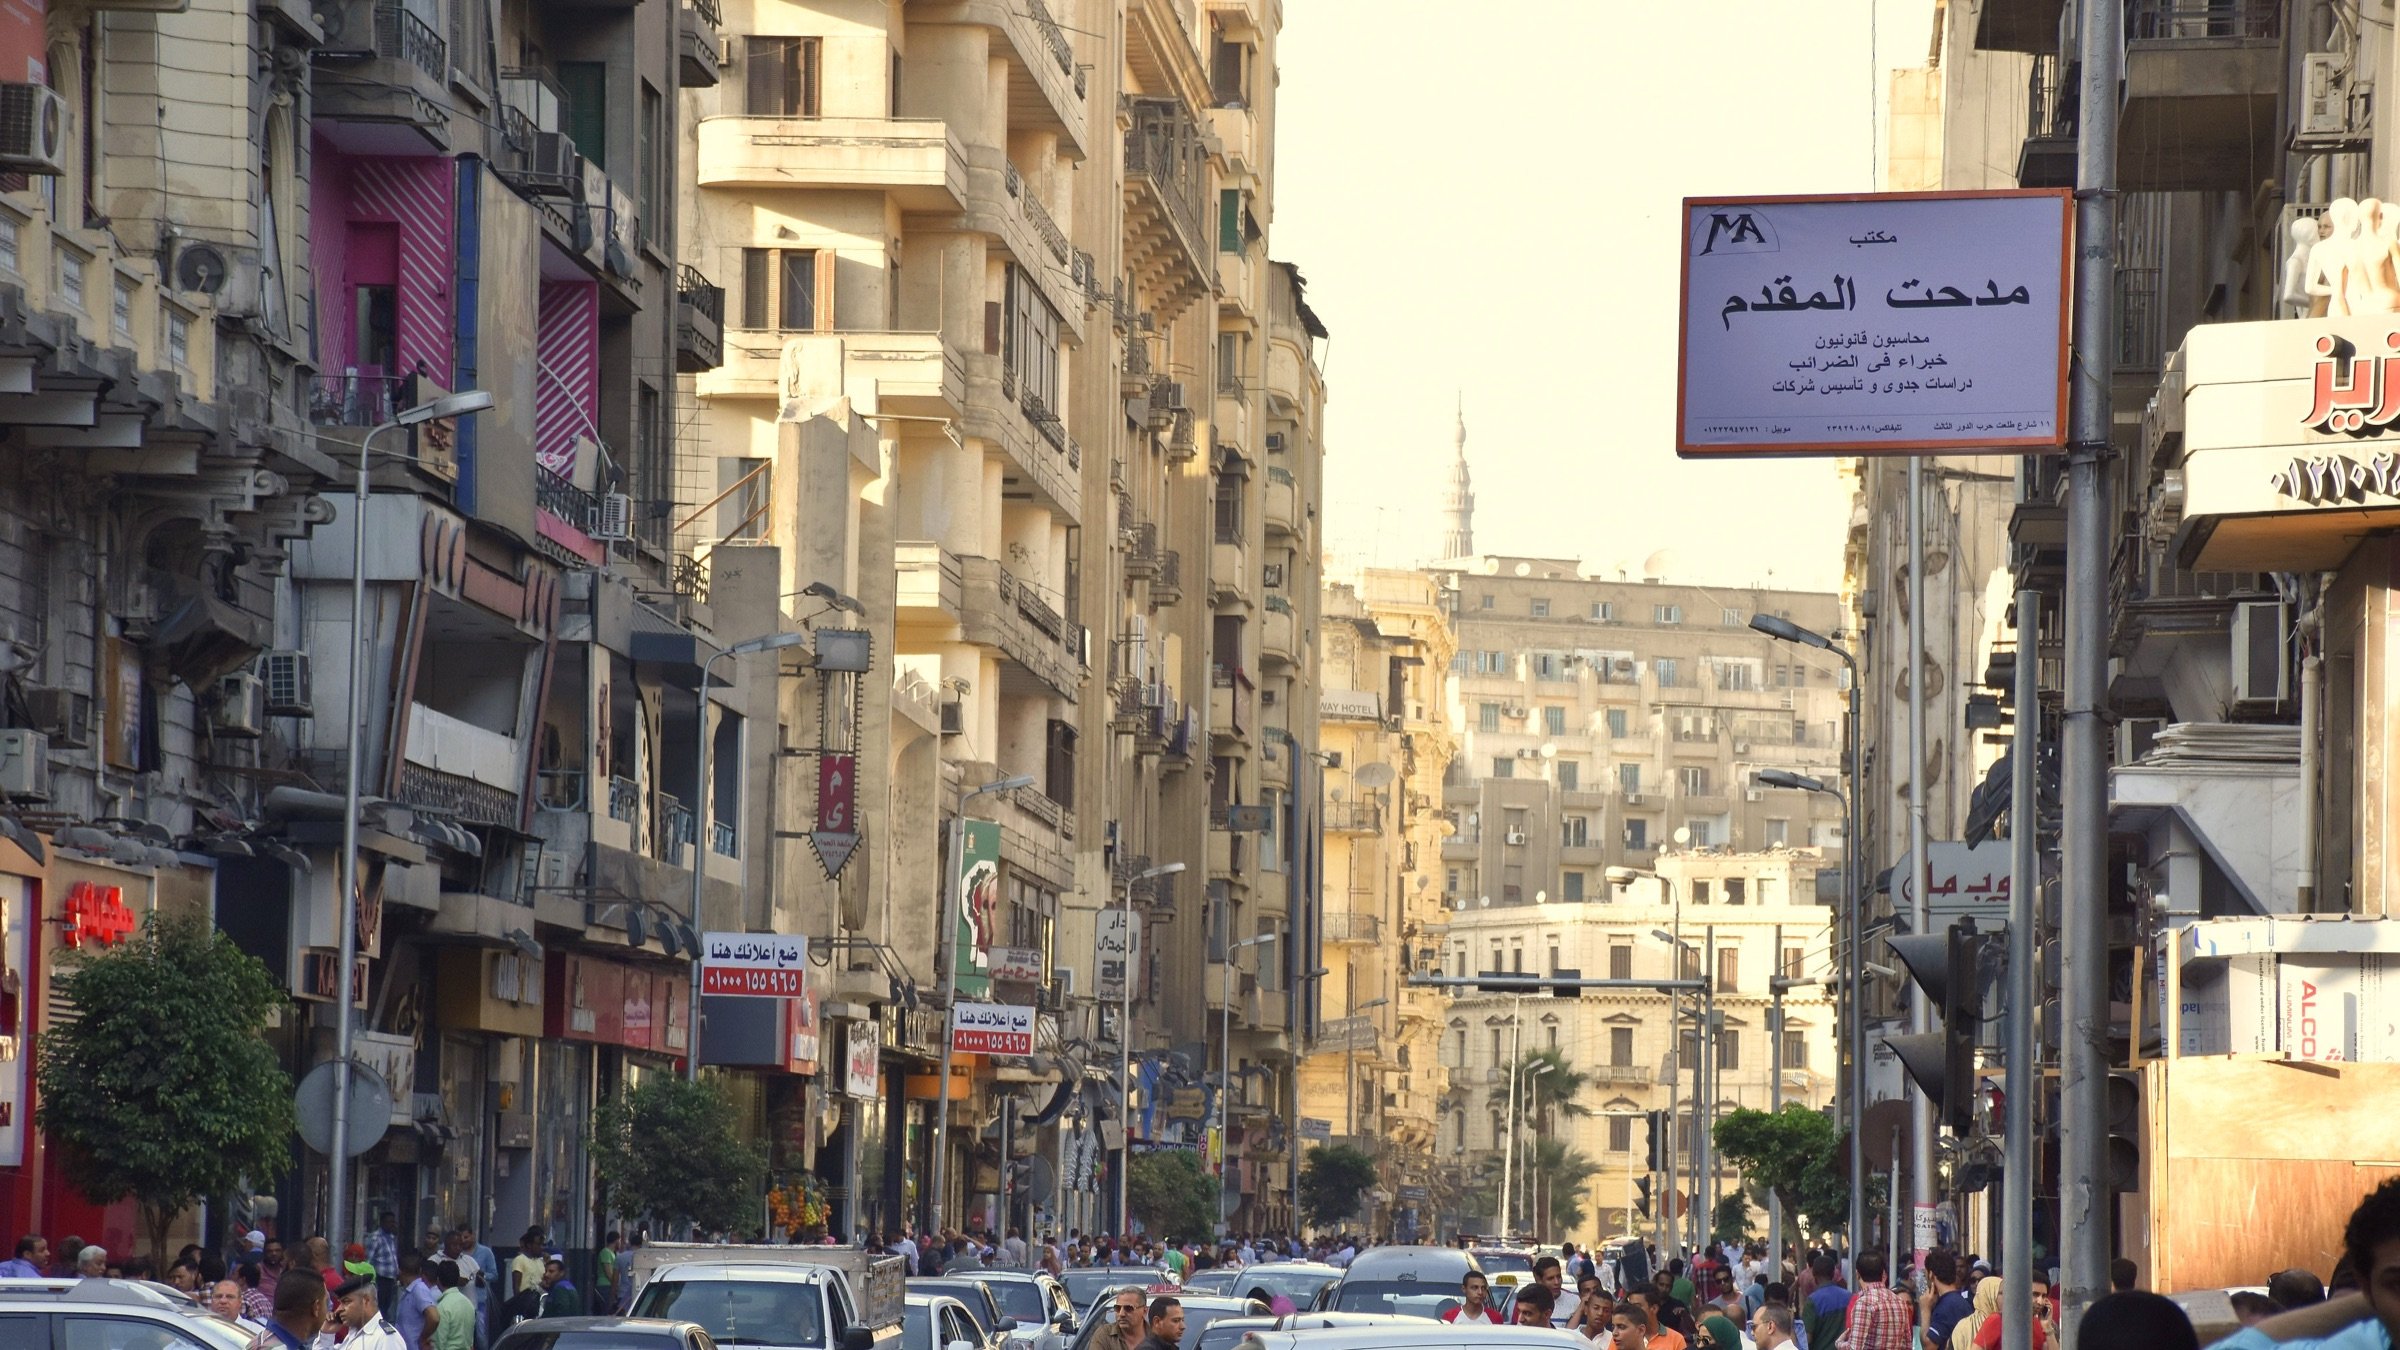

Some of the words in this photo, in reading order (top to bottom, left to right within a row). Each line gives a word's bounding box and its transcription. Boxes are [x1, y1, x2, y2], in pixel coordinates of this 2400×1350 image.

[1849, 231, 1898, 249] مكتب
[1885, 276, 2031, 309] مدحت
[1722, 274, 1857, 331] المقدم
[1815, 331, 1867, 351] قانونيون
[1873, 334, 1930, 351] محاسبون
[1789, 354, 1859, 372] الضرائب
[1899, 353, 1947, 371] خبراء
[1773, 376, 1816, 396] شركات
[1871, 381, 1878, 394] و
[1882, 377, 1920, 395] جدوى
[1925, 377, 1973, 392] دراسات
[2017, 420, 2038, 431] شارع
[1341, 704, 1375, 715] HOTEL
[711, 942, 732, 960] هنا
[734, 942, 776, 962] أعلانك
[777, 946, 798, 968] ضع
[709, 970, 742, 990] ٠١٠٠٠
[745, 971, 767, 991] ١٥٥
[770, 972, 797, 993] ٩٦٥
[960, 1010, 976, 1024] هنا
[1012, 1014, 1028, 1031] ضع
[2302, 980, 2317, 1061] ALCO
[958, 1032, 984, 1048] ٠١٠٠٠
[986, 1033, 1003, 1049] ١٥٥
[1005, 1034, 1027, 1051] ٩٦٥
